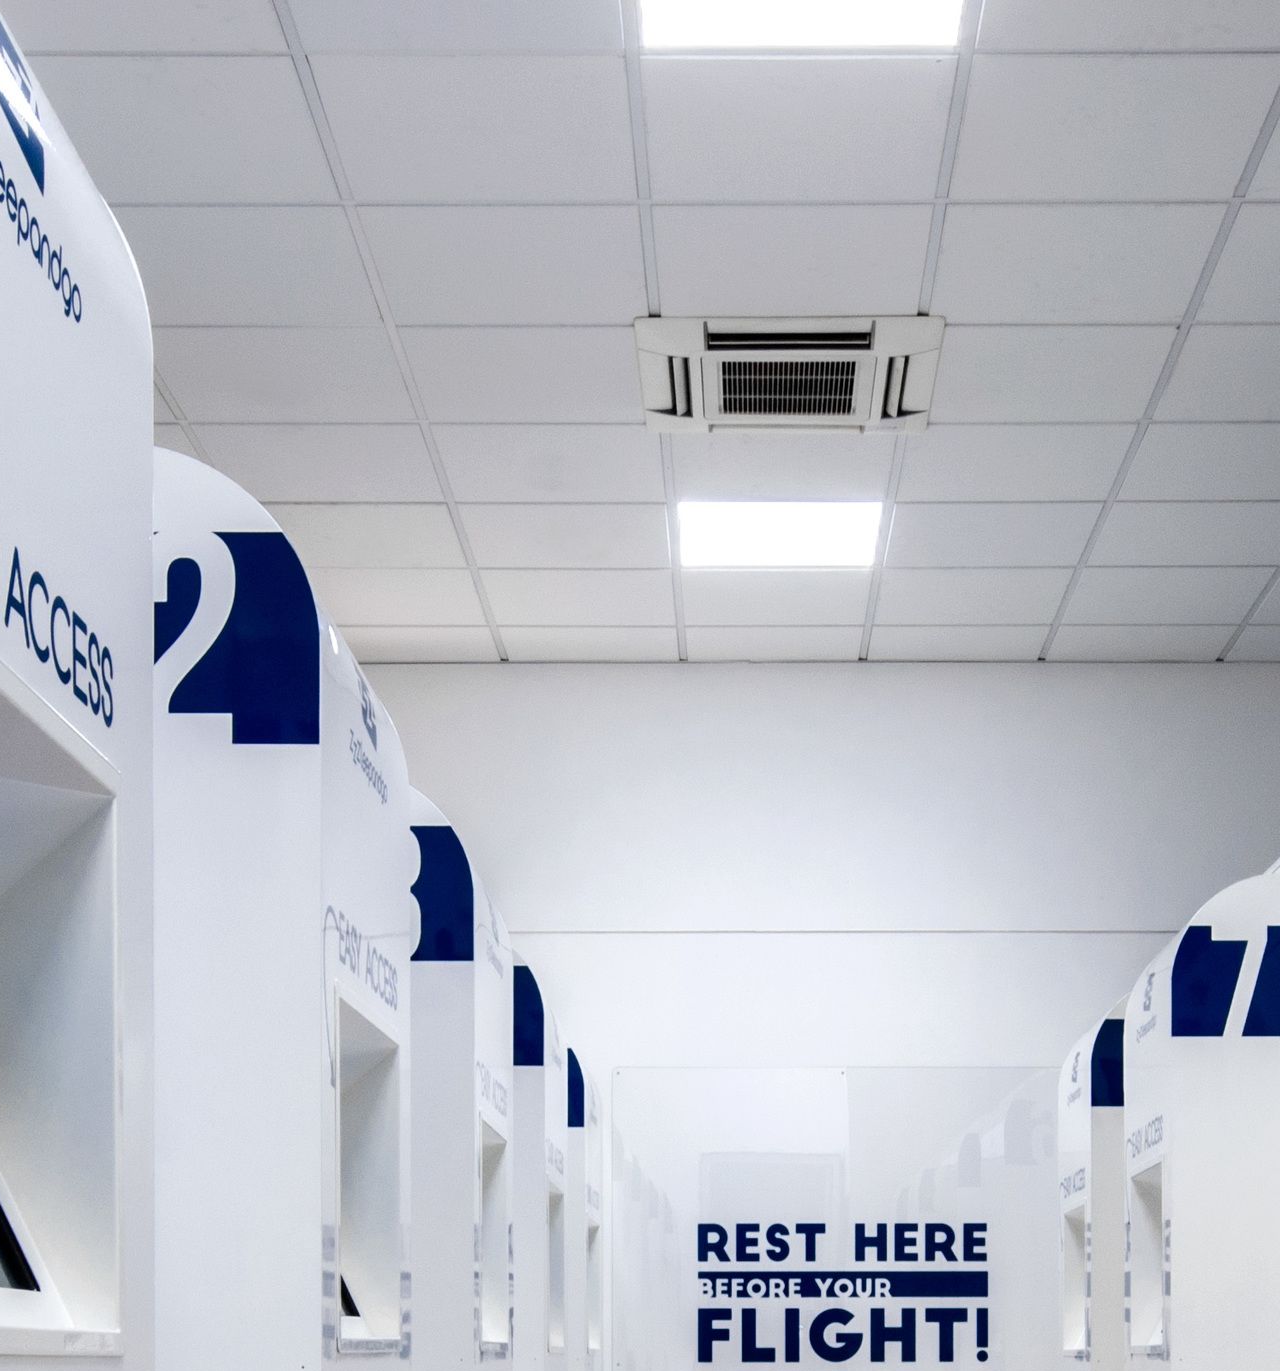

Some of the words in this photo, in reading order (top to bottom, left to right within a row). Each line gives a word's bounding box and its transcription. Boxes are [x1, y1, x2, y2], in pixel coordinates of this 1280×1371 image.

[4, 546, 113, 727] ACCESS
[153, 529, 237, 743] 2
[338, 910, 361, 978] EASY
[365, 941, 398, 1011] ACCESS
[1211, 925, 1268, 1037] 7
[697, 1223, 826, 1262] REST
[854, 1223, 987, 1262] HERE
[698, 1278, 802, 1298] BEFORE
[814, 1278, 893, 1298] YOUR
[697, 1307, 989, 1362] FLIGHT!
